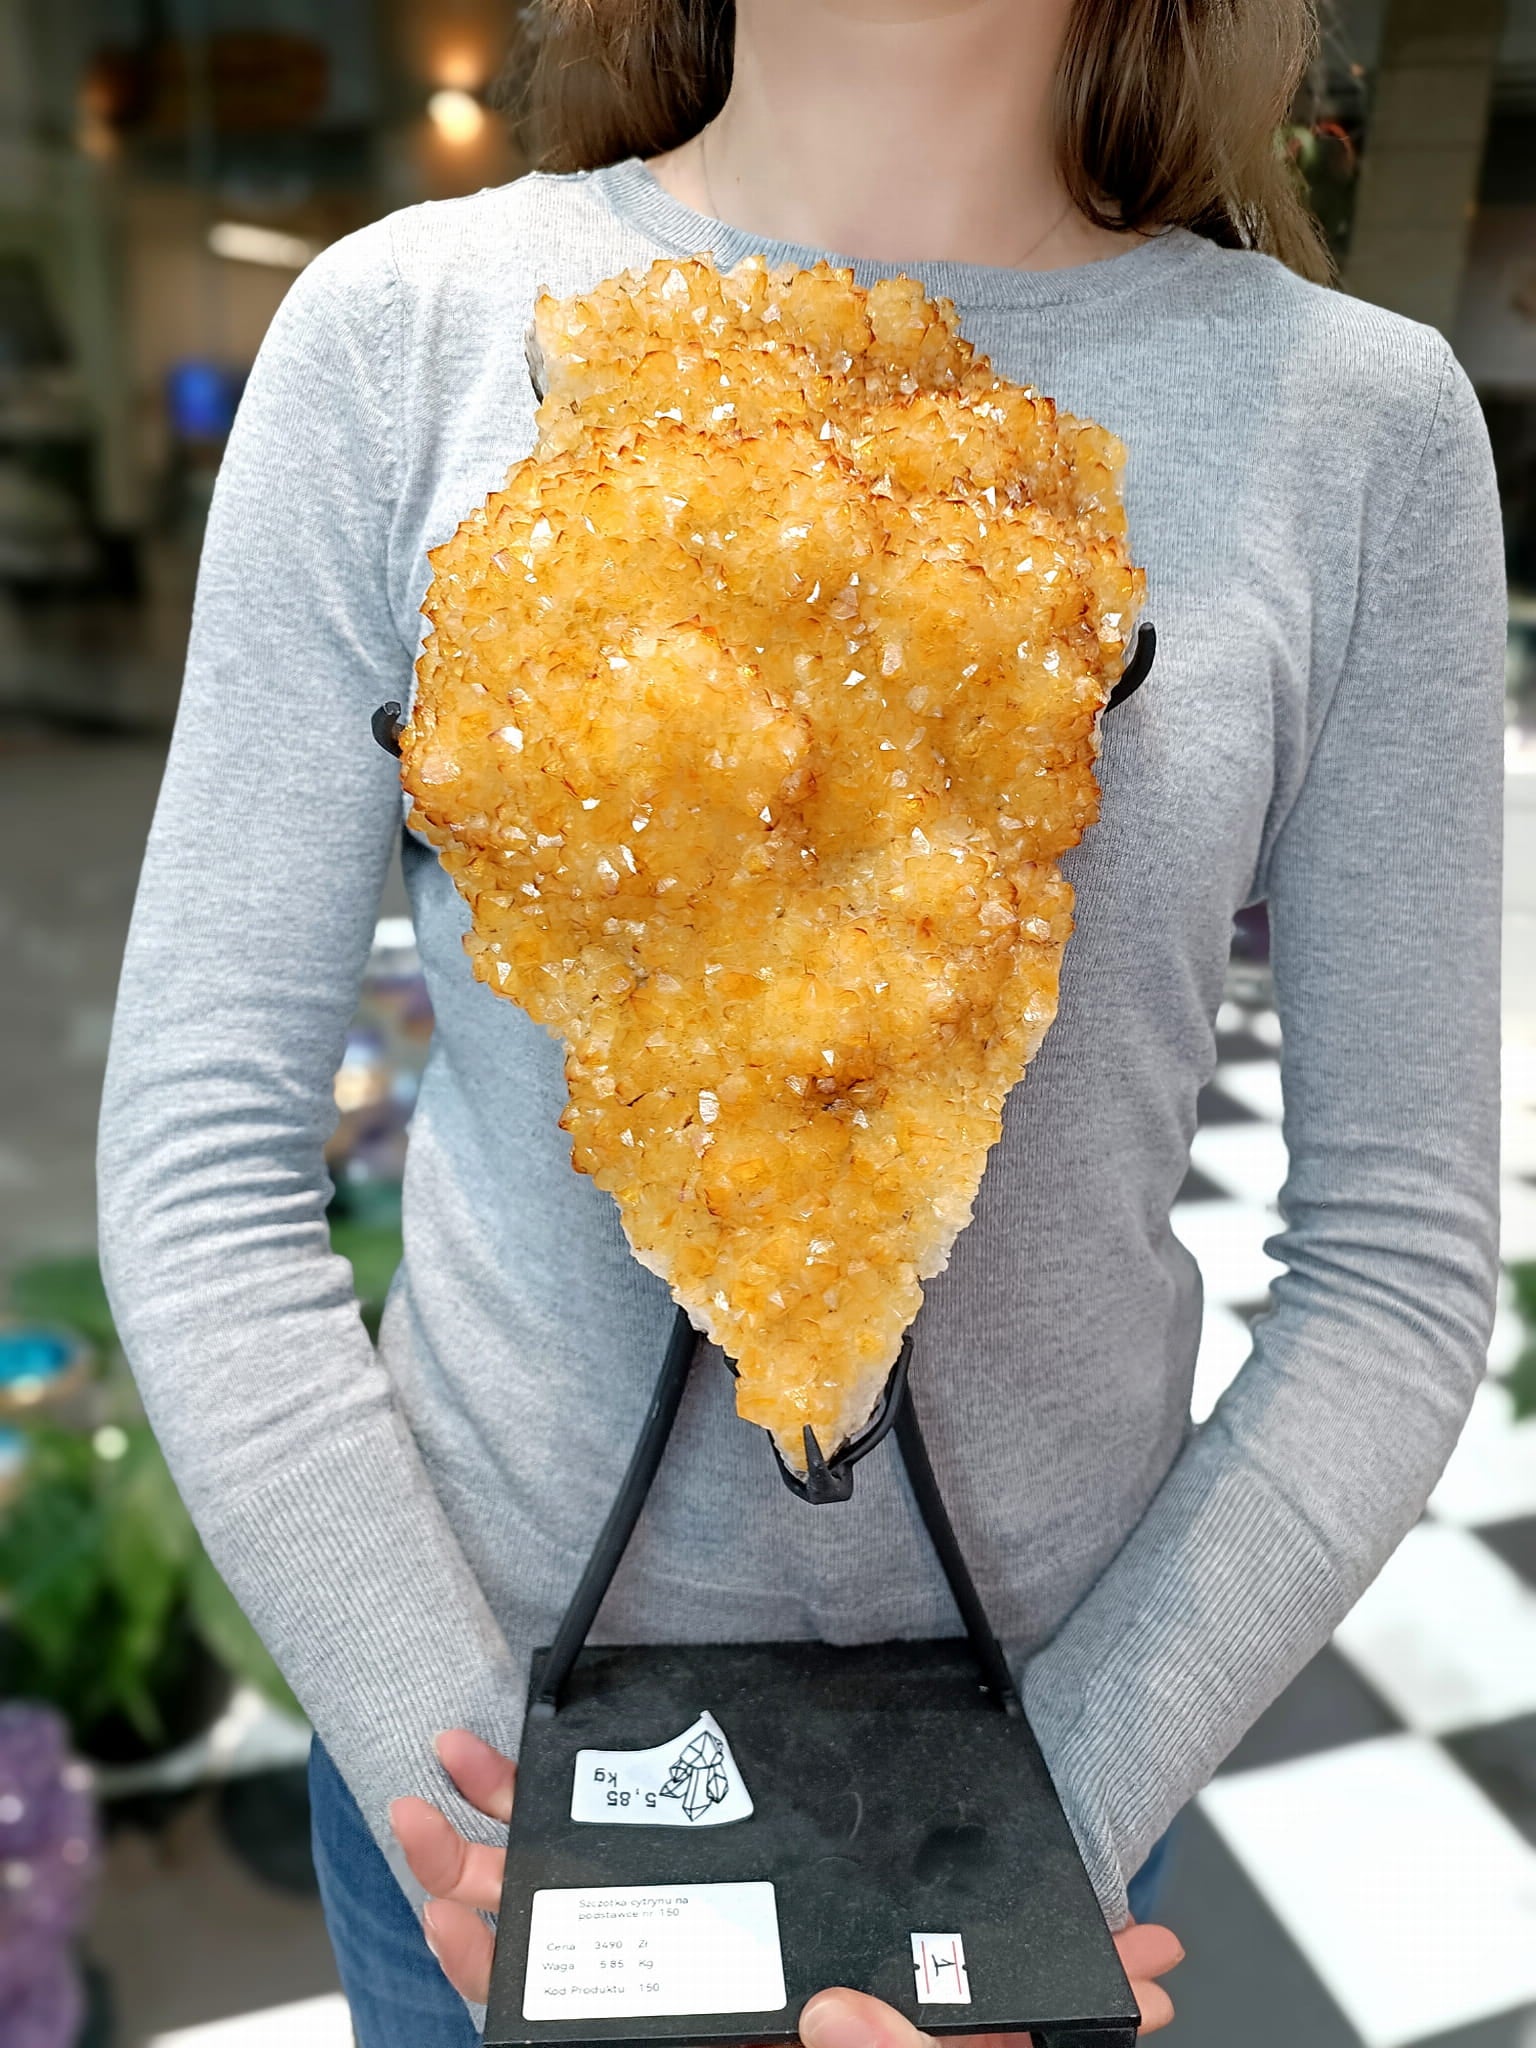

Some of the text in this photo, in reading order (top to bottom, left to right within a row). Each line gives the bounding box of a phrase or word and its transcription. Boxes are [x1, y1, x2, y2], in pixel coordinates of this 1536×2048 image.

[594, 1768, 618, 1787] kg
[606, 1789, 657, 1807] 5,85
[579, 1899, 627, 1908] Szczotka
[631, 1898, 672, 1908] cytrynu
[578, 1910, 639, 1921] podstawce
[660, 1908, 680, 1917] 150
[546, 1942, 576, 1951] Cena
[595, 1940, 623, 1950] 3490
[542, 1962, 575, 1973] Waga
[639, 1960, 654, 1970] Kg
[544, 1983, 660, 1996] Kod Produktu 150
